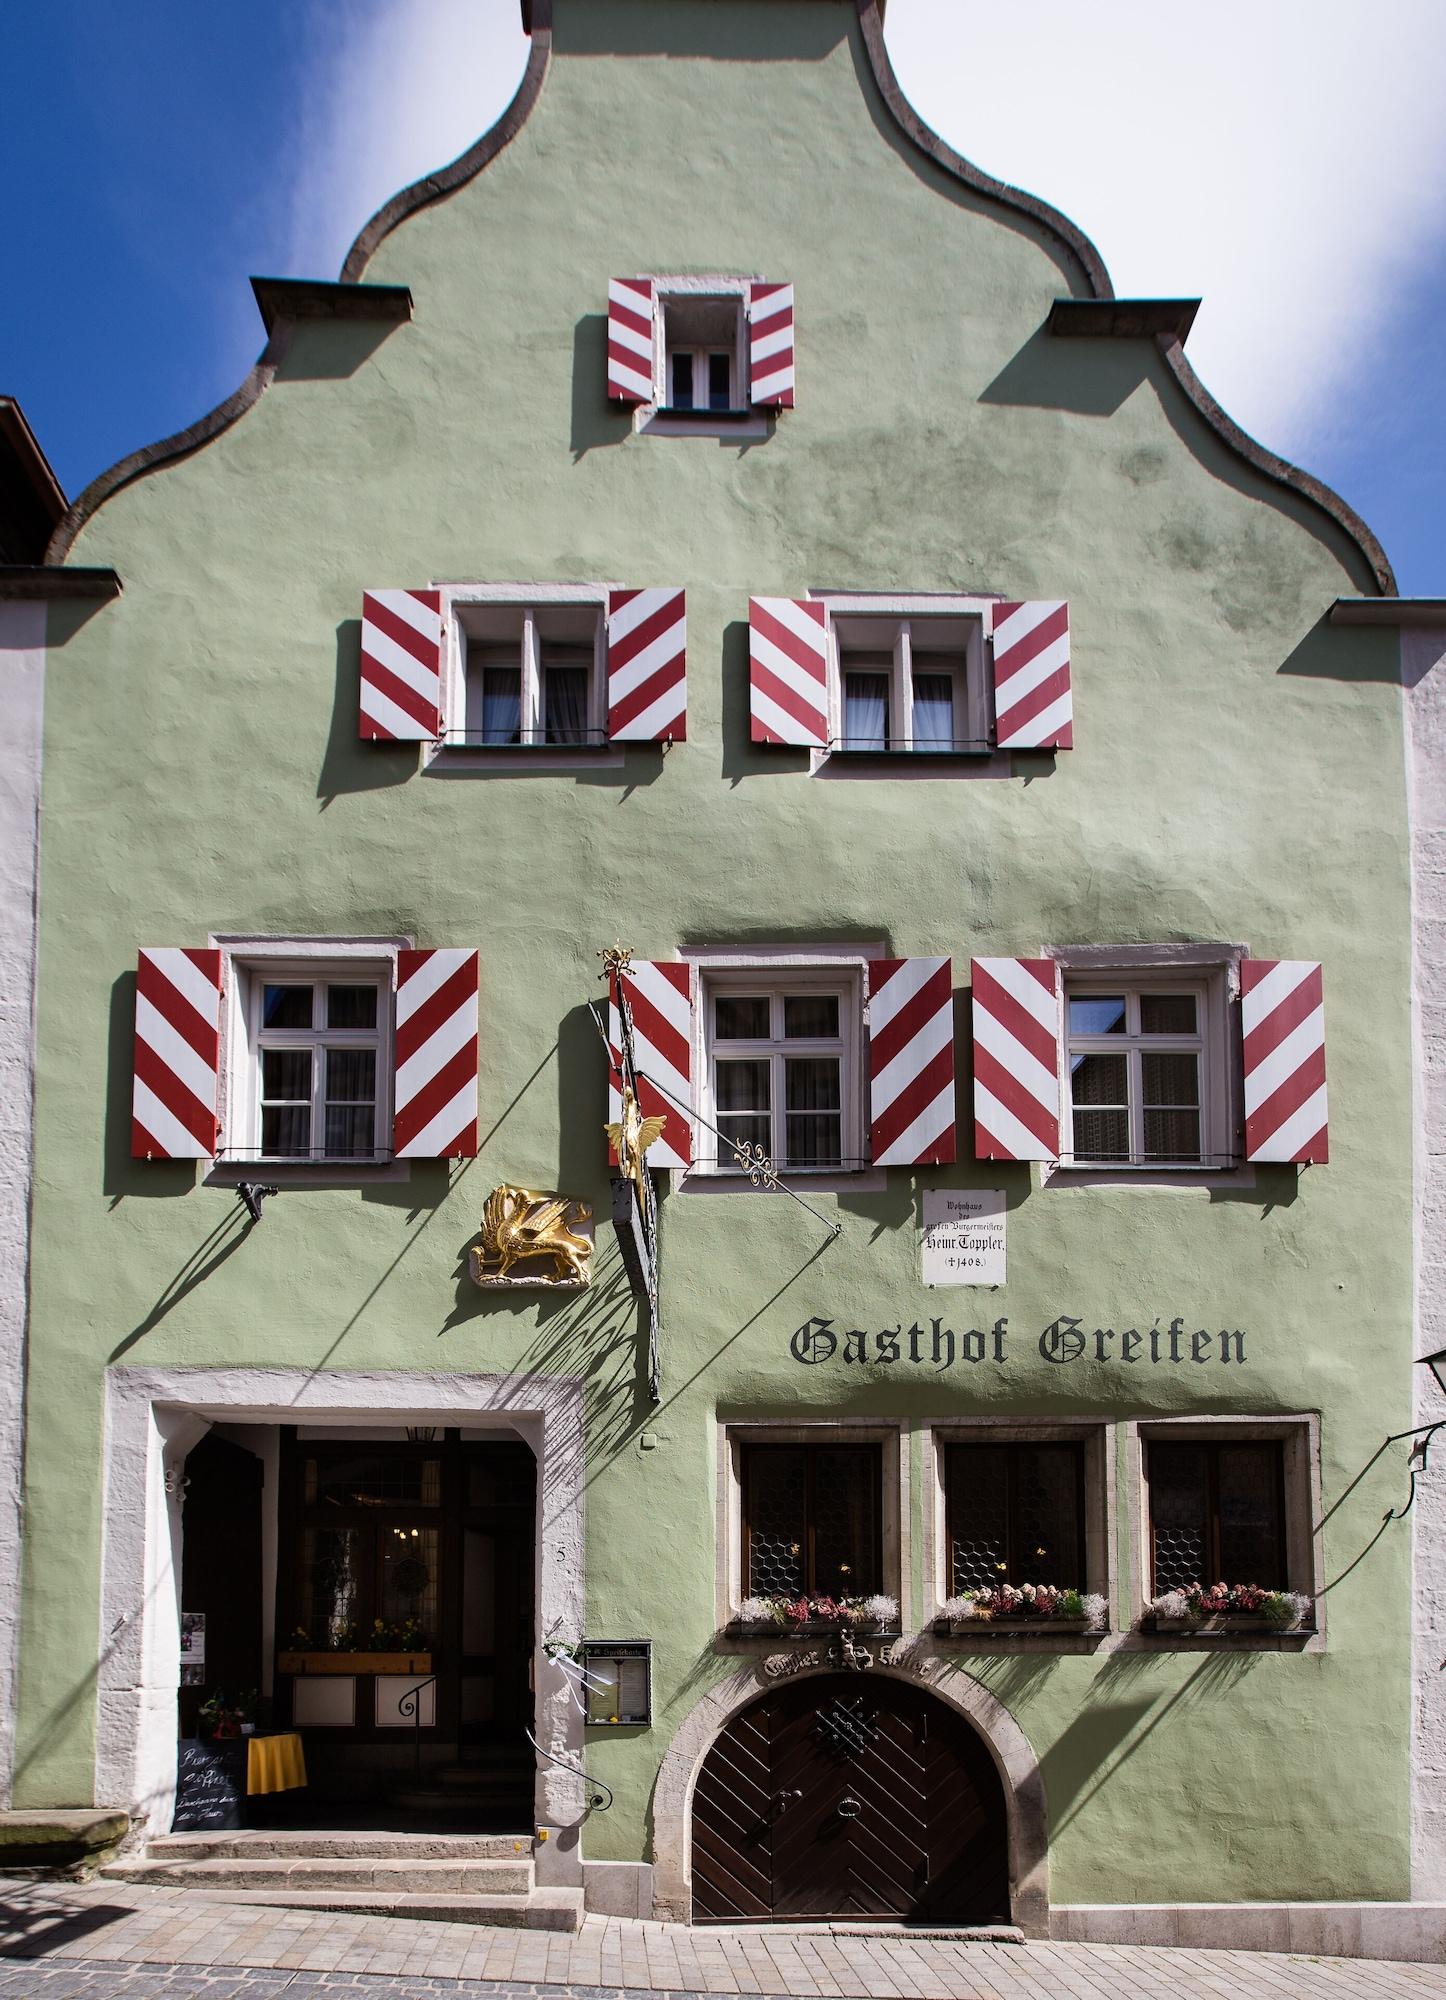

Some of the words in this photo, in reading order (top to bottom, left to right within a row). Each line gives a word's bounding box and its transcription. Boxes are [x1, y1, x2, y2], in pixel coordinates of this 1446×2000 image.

[958, 1212, 970, 1220] des
[790, 1316, 1009, 1372] Gasthof
[1038, 1315, 1248, 1365] Greifen
[556, 1547, 566, 1563] 5
